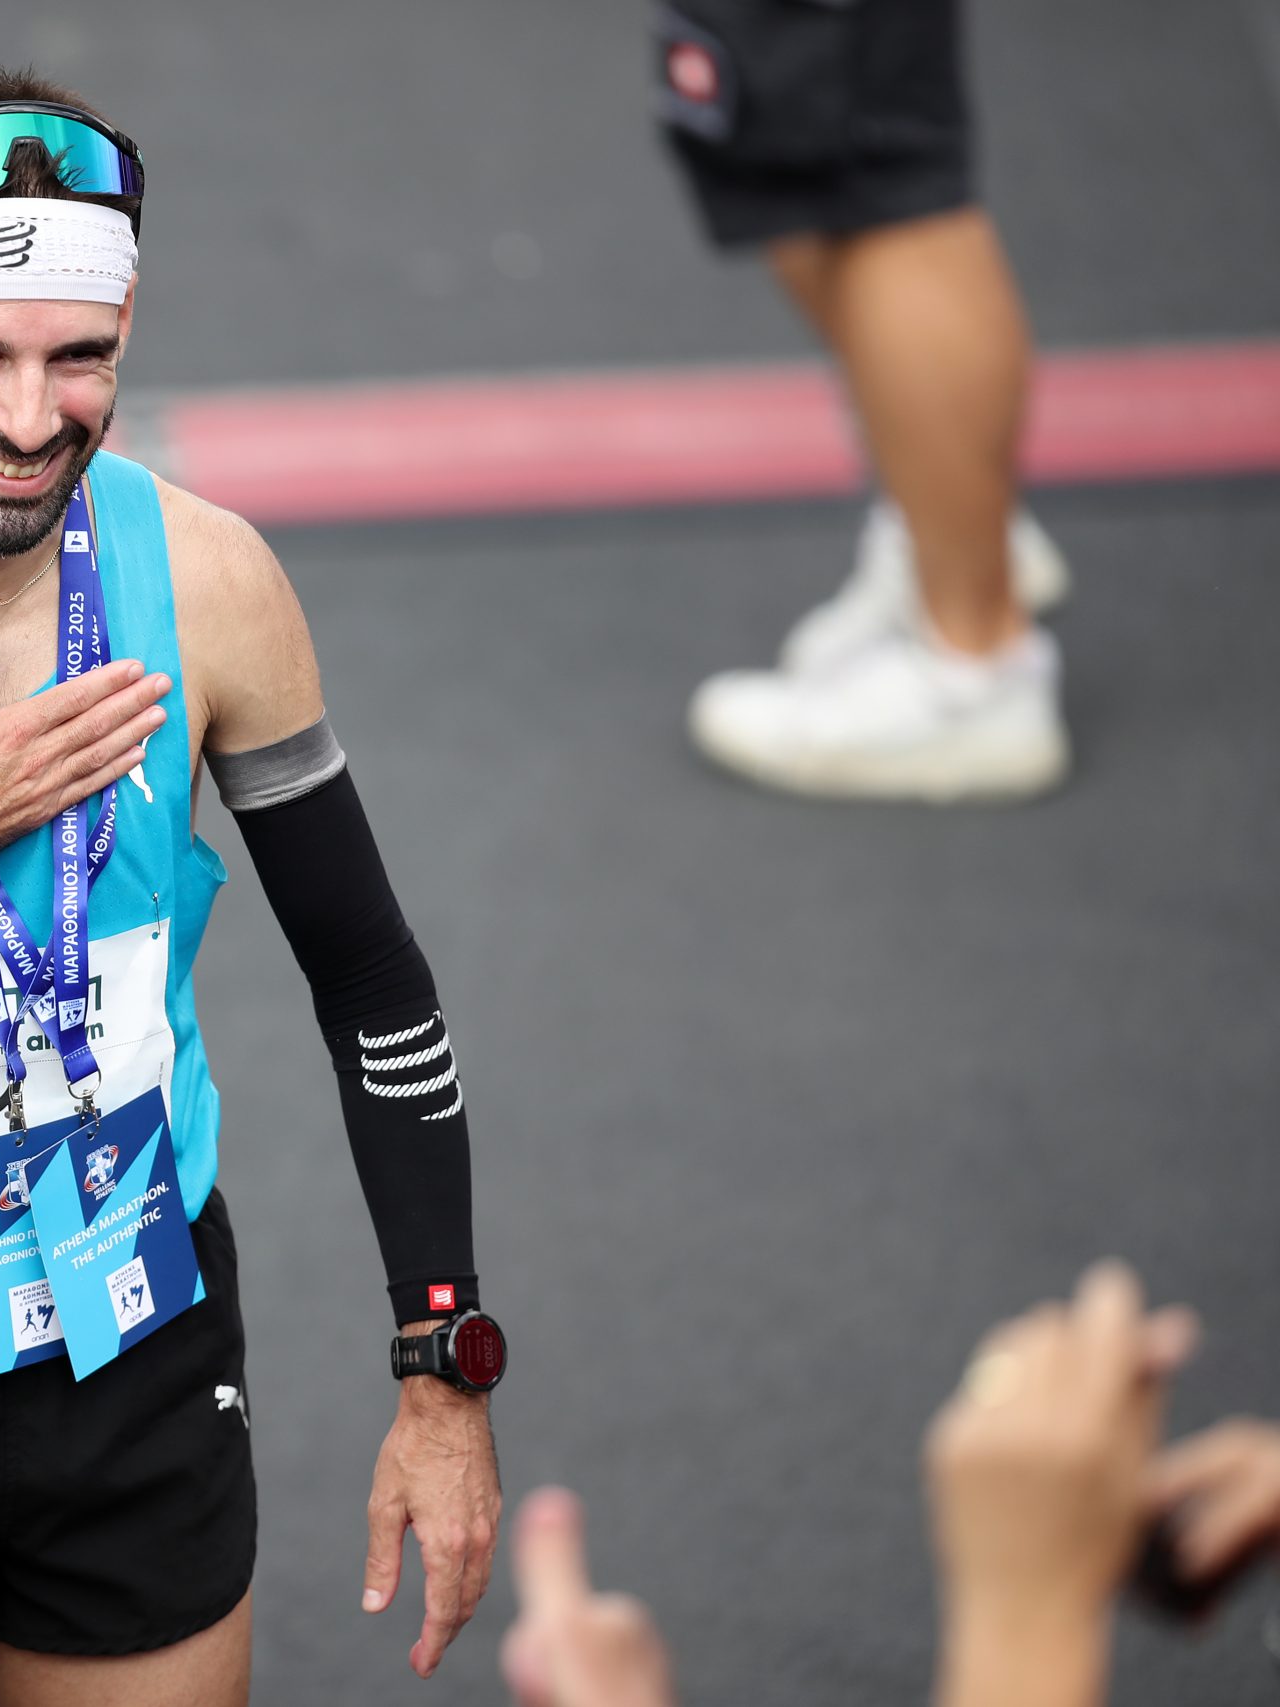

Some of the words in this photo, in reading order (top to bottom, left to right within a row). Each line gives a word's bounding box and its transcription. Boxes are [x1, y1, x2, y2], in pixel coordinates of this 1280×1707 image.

[68, 592, 85, 635] 2025
[61, 860, 80, 984] ΜΑΡΑΘΩΝΙΟΣ
[52, 1223, 97, 1260] ATHENS
[99, 1181, 170, 1231] MARATHON.
[70, 1246, 95, 1270] THE
[97, 1206, 162, 1256] AUTHENTIC
